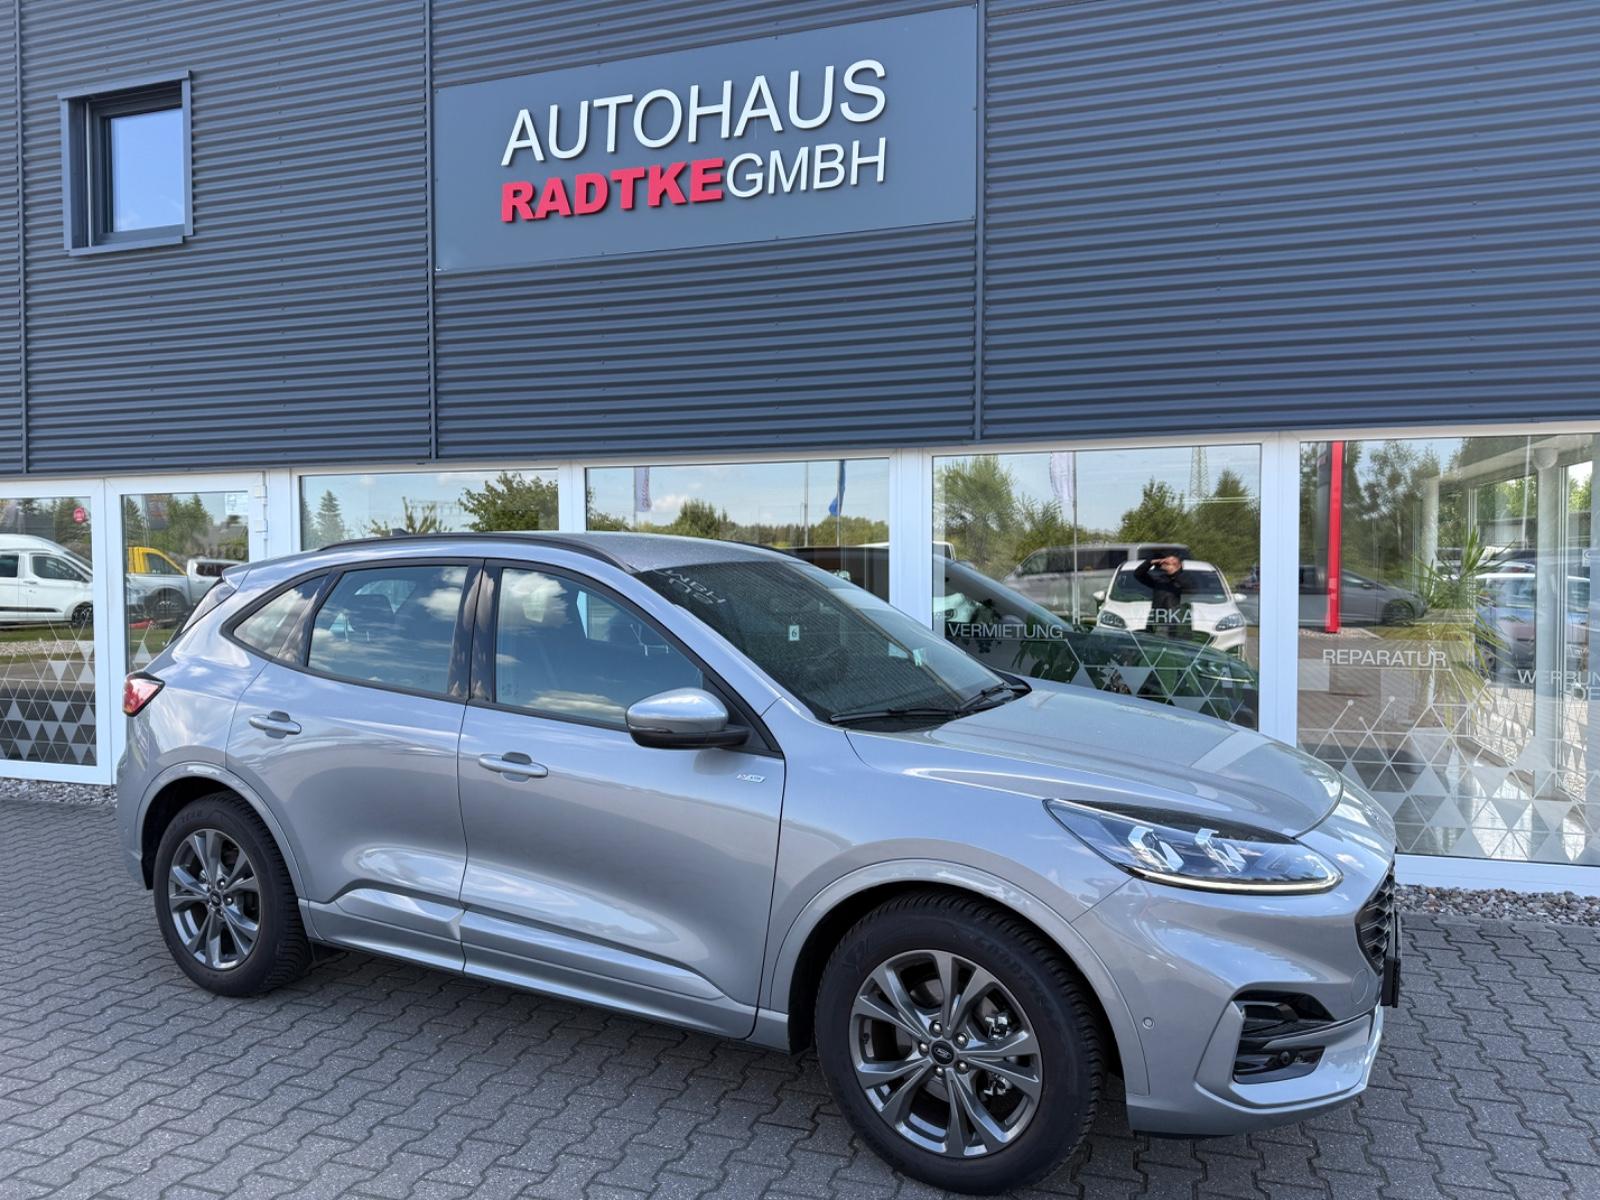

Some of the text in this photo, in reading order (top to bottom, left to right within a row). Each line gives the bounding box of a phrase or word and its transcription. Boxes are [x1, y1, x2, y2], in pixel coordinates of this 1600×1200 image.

[500, 59, 887, 167] AUTOHAUS
[948, 623, 1063, 639] VERMIETUNG
[1322, 648, 1447, 667] REPARATUR
